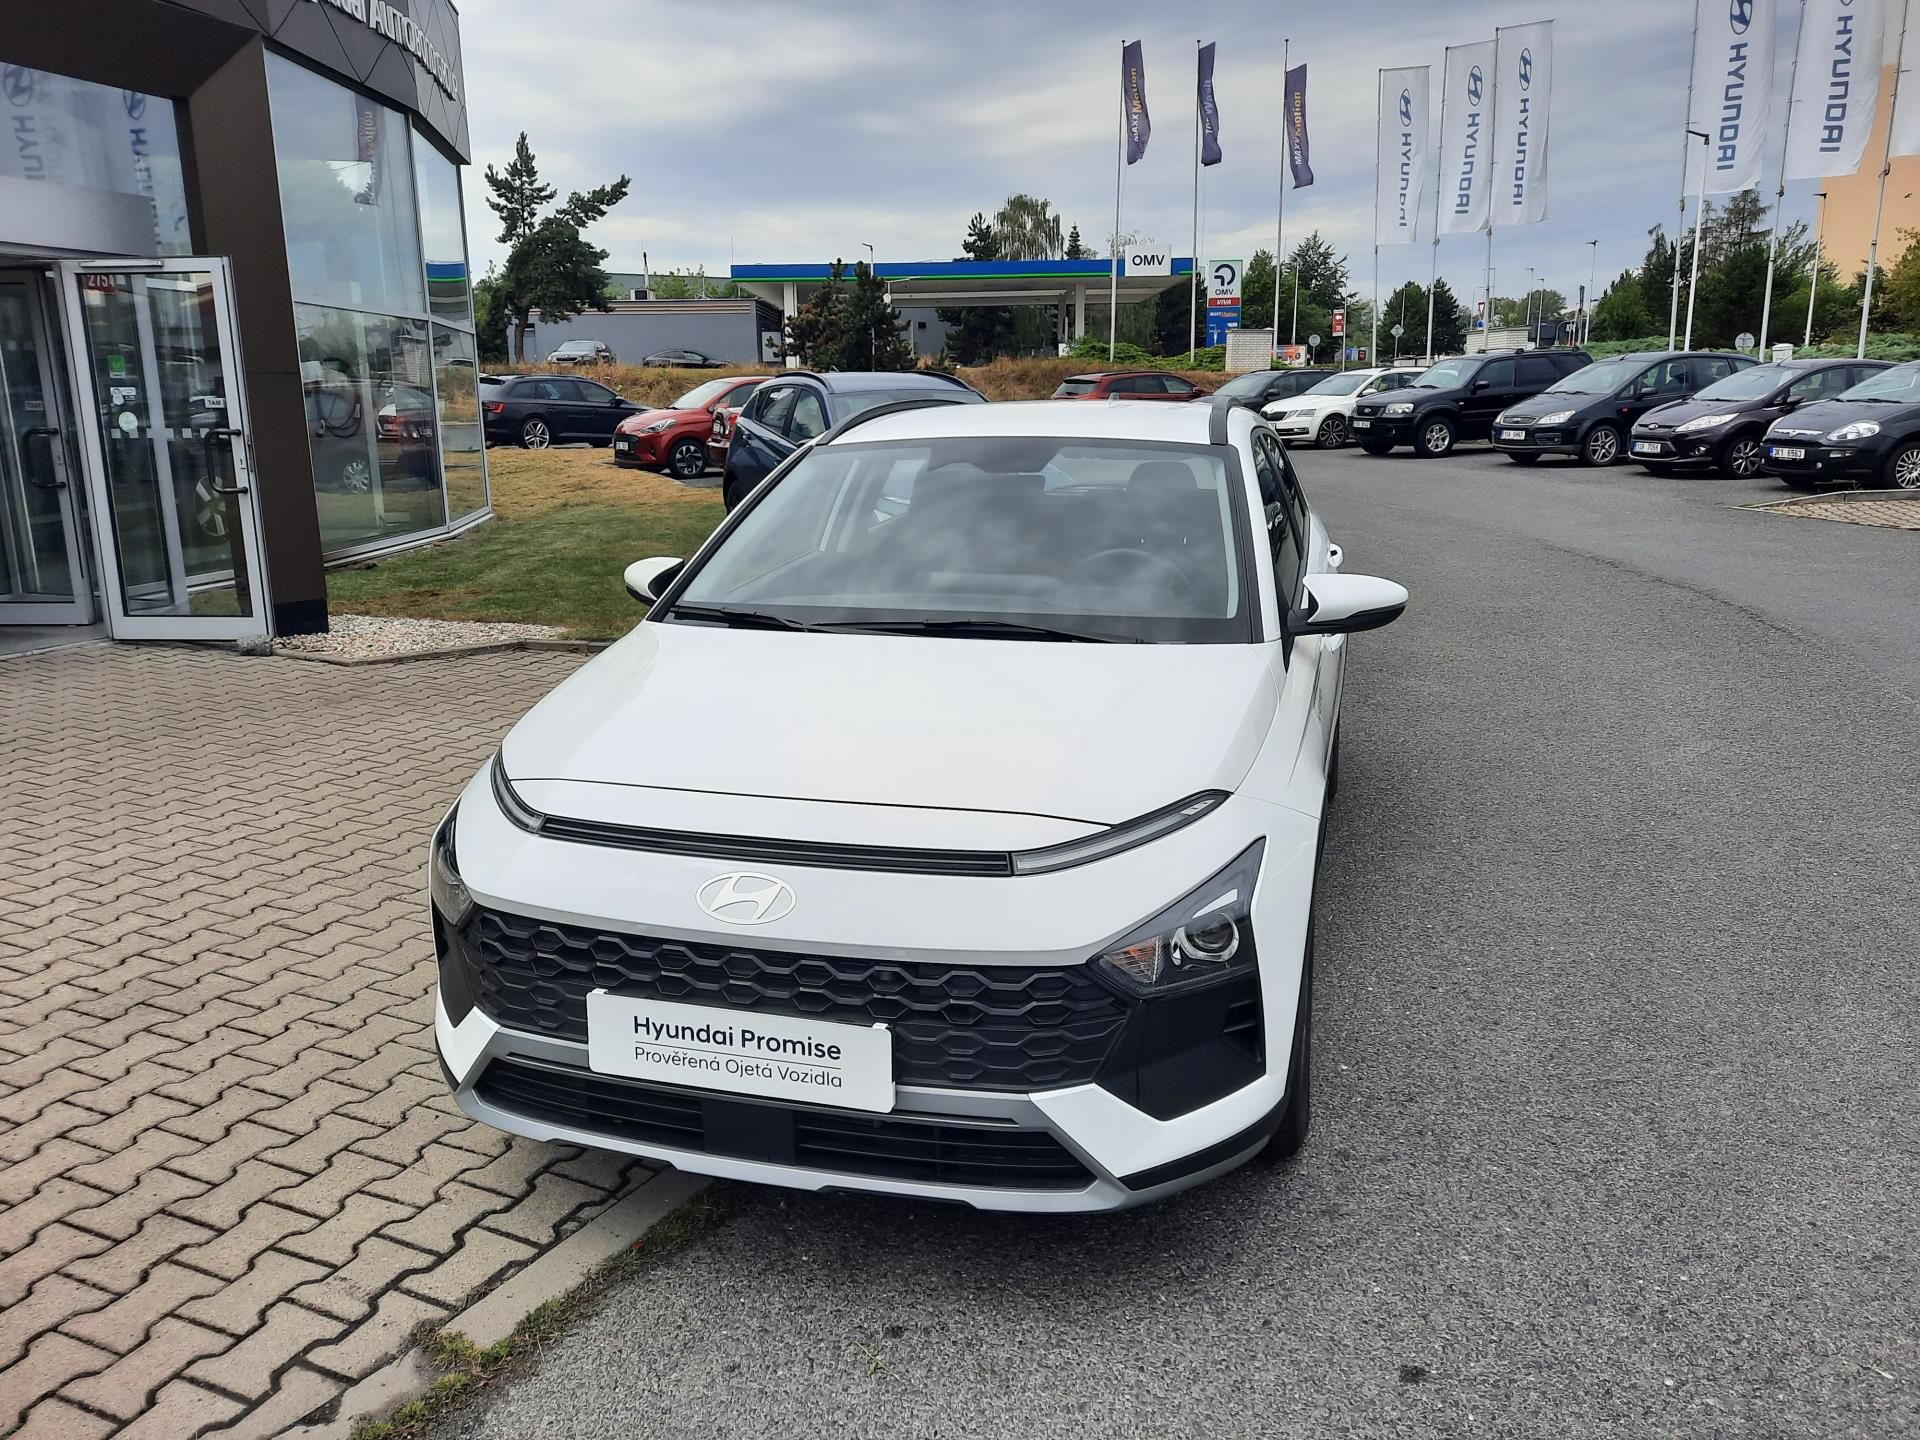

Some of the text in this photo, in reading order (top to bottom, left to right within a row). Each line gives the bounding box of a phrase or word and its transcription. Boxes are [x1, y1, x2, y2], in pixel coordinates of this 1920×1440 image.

[1716, 42, 1748, 171] HYUNDAI
[1818, 15, 1854, 152] HYUNDAI
[1399, 132, 1412, 227] HYUNDAI
[1455, 112, 1480, 215] HYUNDAI
[1512, 98, 1530, 206] HYUNDAI
[1132, 254, 1165, 266] OMV
[633, 1015, 842, 1060] Hyundai Promise
[634, 1046, 842, 1088] Prověřená Ojetá Vozidla
